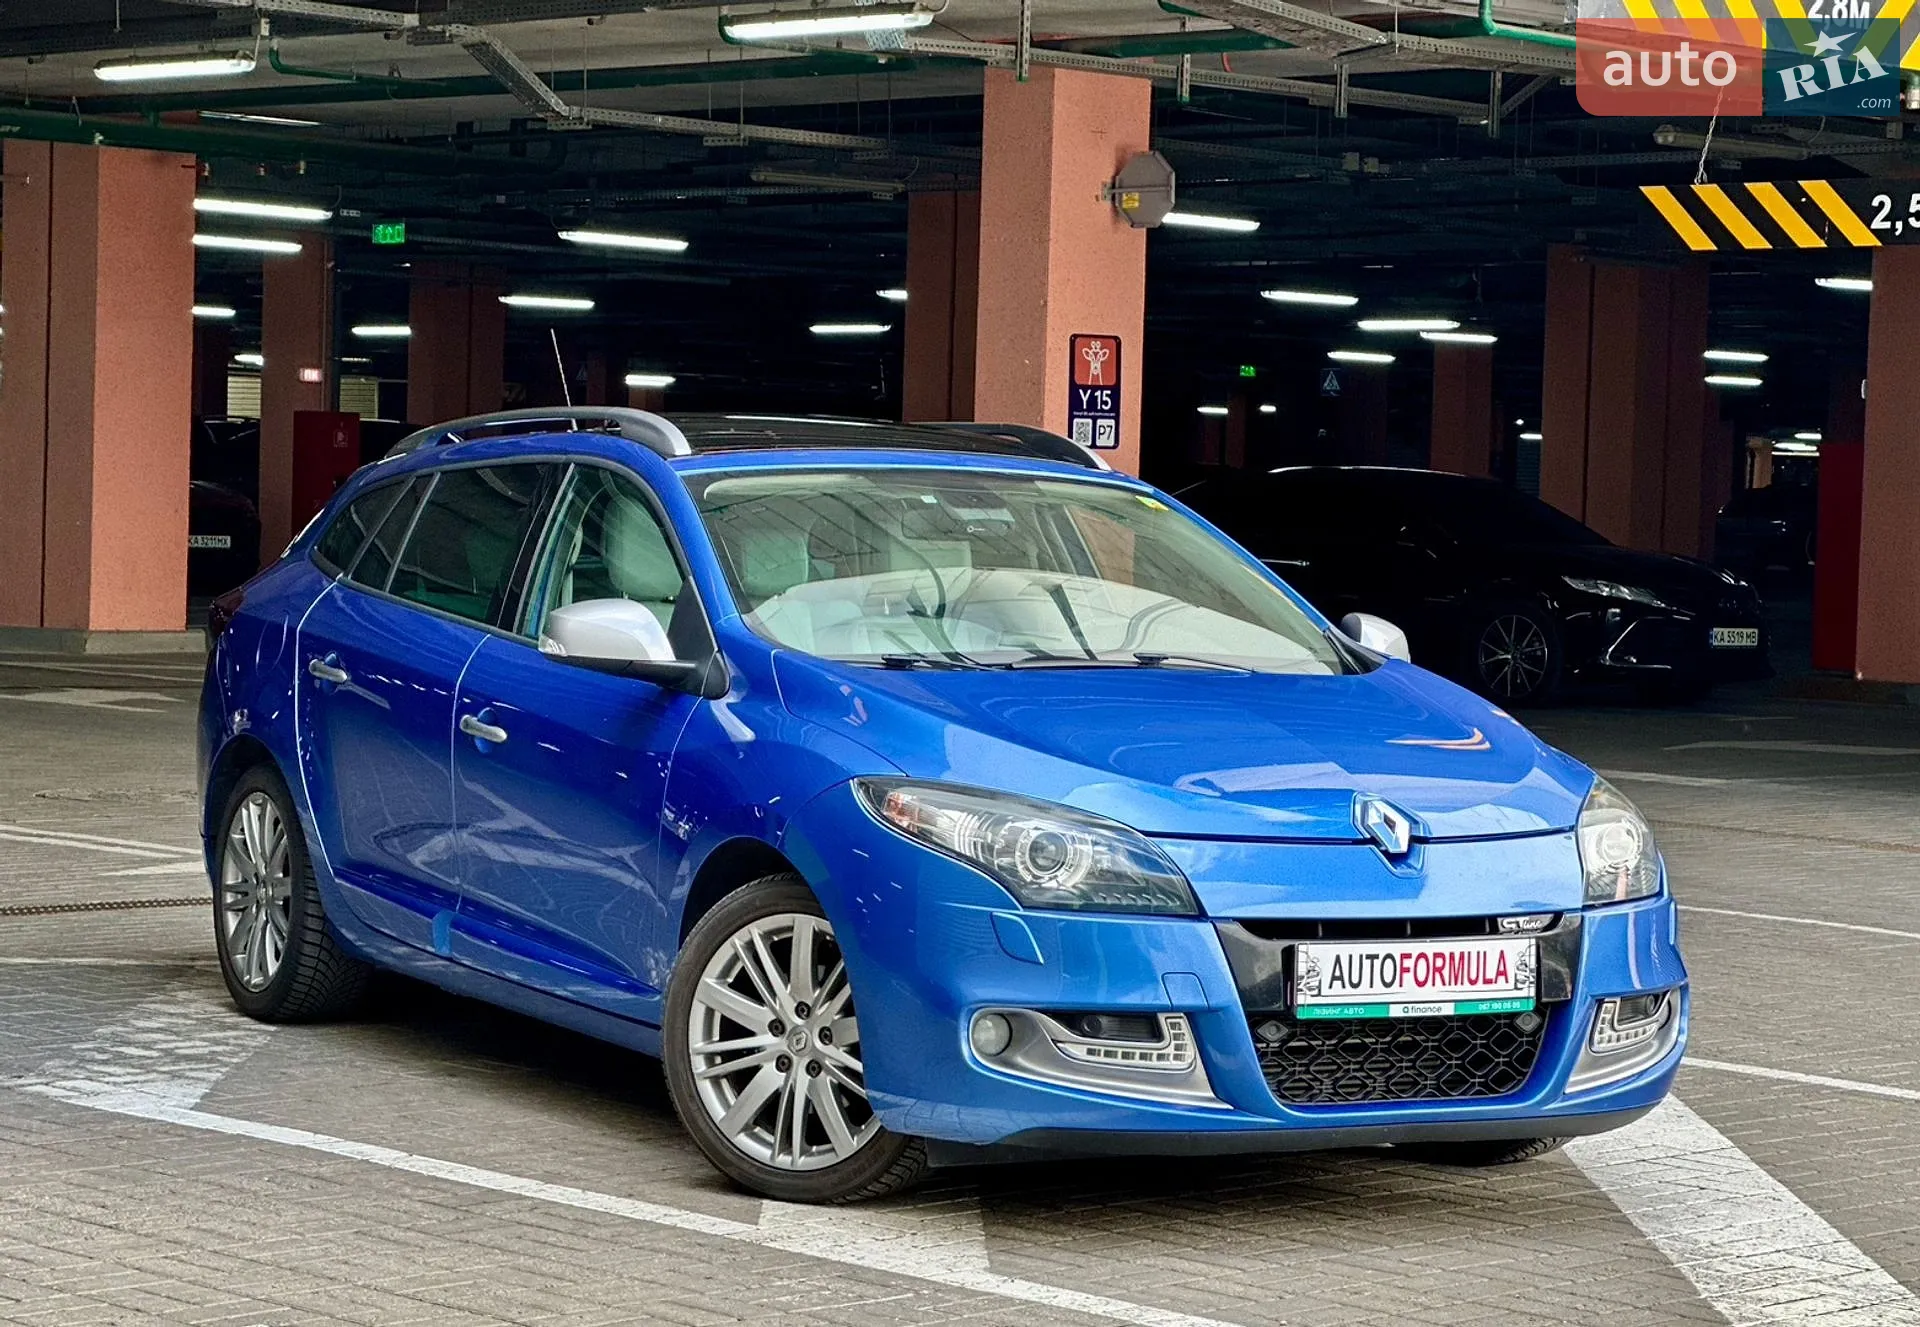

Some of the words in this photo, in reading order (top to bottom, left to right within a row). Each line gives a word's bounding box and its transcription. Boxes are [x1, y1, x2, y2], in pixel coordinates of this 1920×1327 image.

[1079, 389, 1092, 409] Y
[1094, 389, 1112, 410] 15
[1098, 424, 1113, 441] P7
[1328, 949, 1510, 989] AUTOFORMULA
[1411, 1004, 1442, 1014] finance
